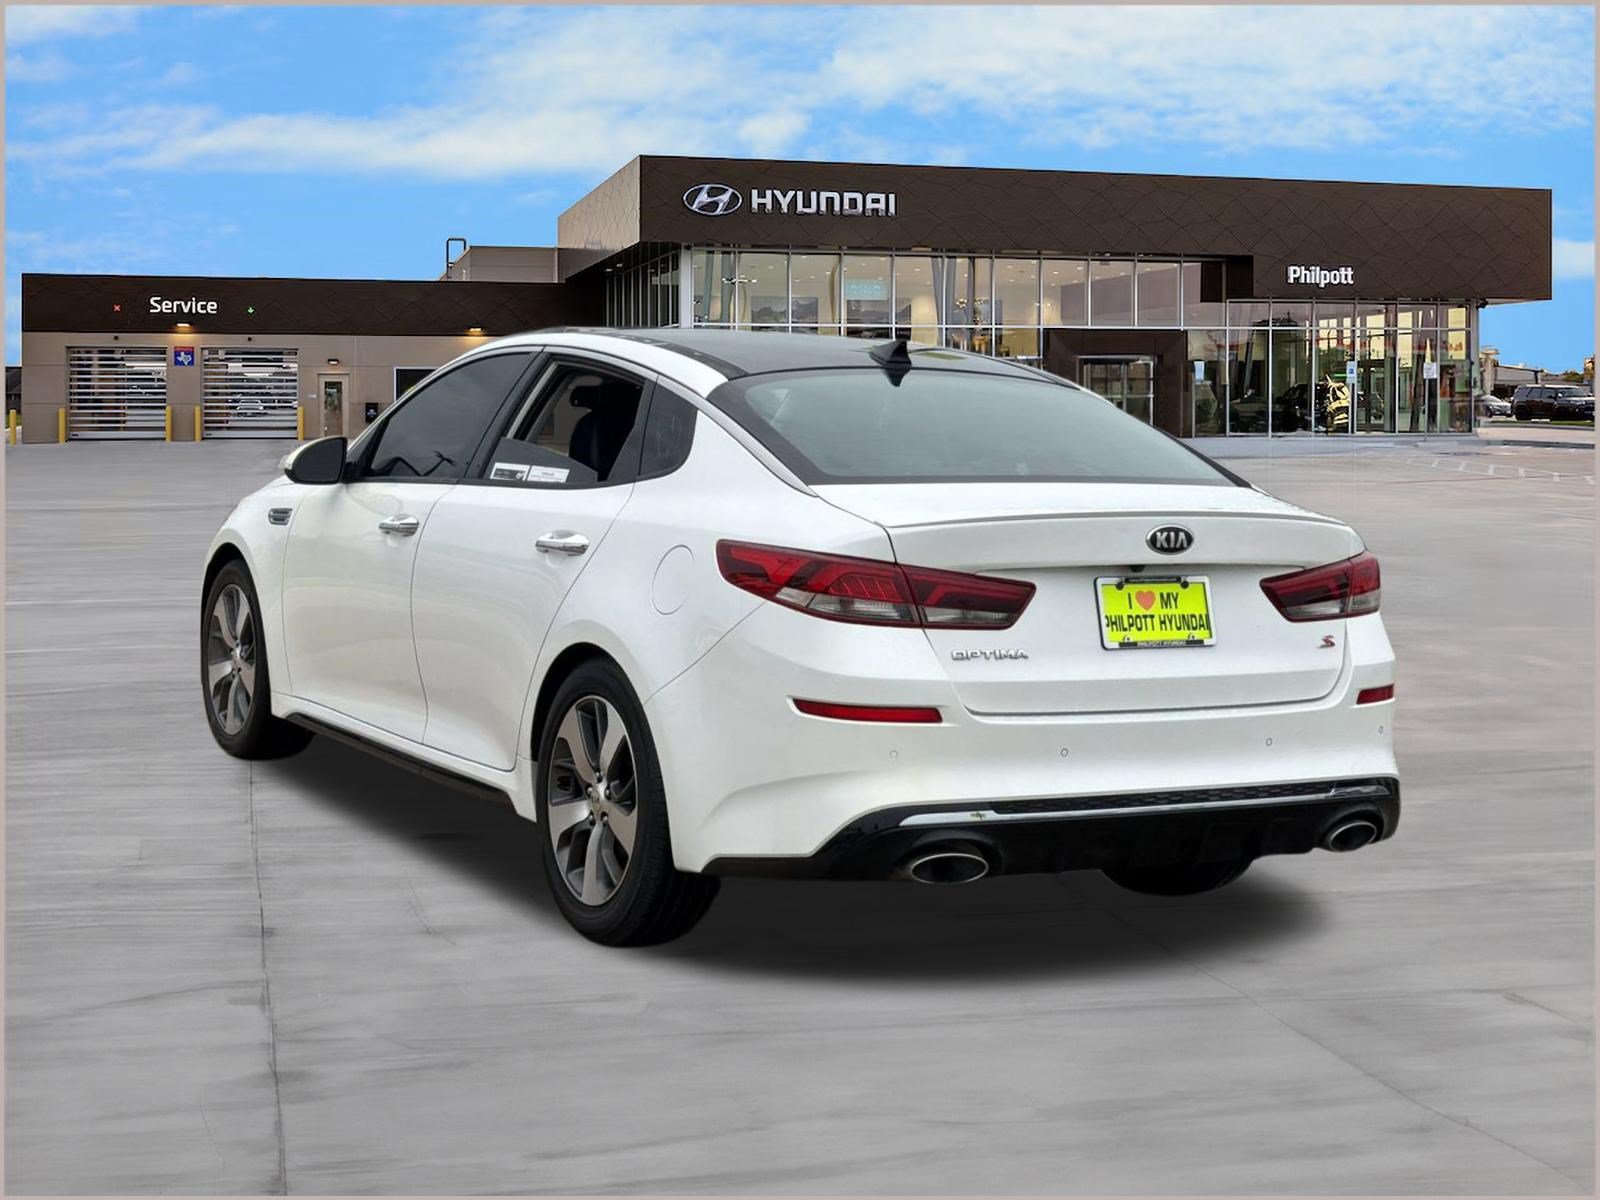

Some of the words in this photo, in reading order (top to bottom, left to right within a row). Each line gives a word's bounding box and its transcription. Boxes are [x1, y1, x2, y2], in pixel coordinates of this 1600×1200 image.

[751, 189, 896, 216] HYUNDAI
[1287, 265, 1354, 288] Philpott
[149, 296, 218, 314] Service
[1155, 531, 1188, 549] KIA
[1127, 592, 1133, 610] I
[1160, 592, 1179, 610] MY
[1159, 613, 1209, 631] HYUNDAI
[951, 648, 1029, 661] OPTIMA
